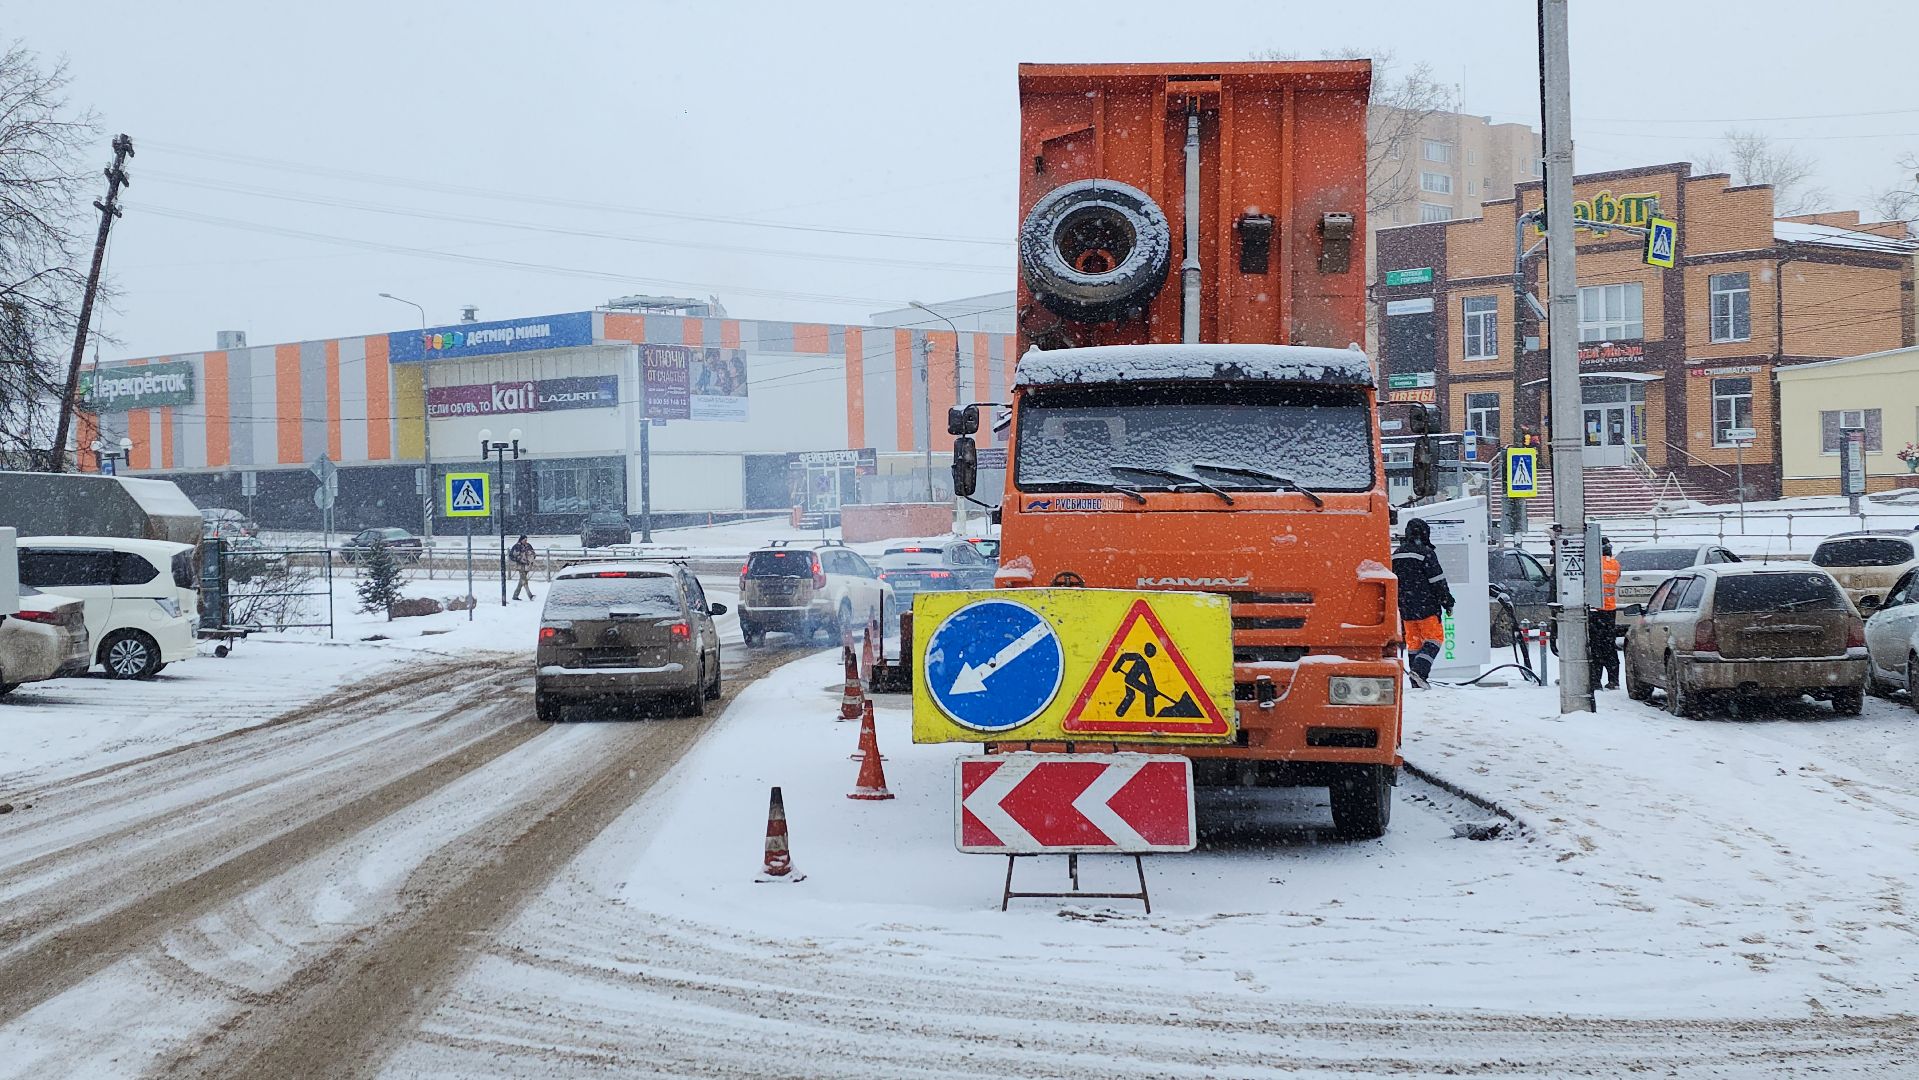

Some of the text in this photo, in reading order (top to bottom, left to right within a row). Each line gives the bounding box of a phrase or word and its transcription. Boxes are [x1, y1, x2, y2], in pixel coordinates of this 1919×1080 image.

[466, 324, 550, 346] детмир мини
[647, 350, 685, 369] КЛЮЧИ
[647, 370, 686, 382] ОТ СЧАСТЬЯ
[428, 382, 535, 415] ЕСЛИ ОБУВЬ, ТО kari
[539, 391, 599, 403] LAZURIT
[798, 450, 860, 463] ФЕЙЕРВЕРКИ
[1137, 576, 1249, 587] KAMAZ
